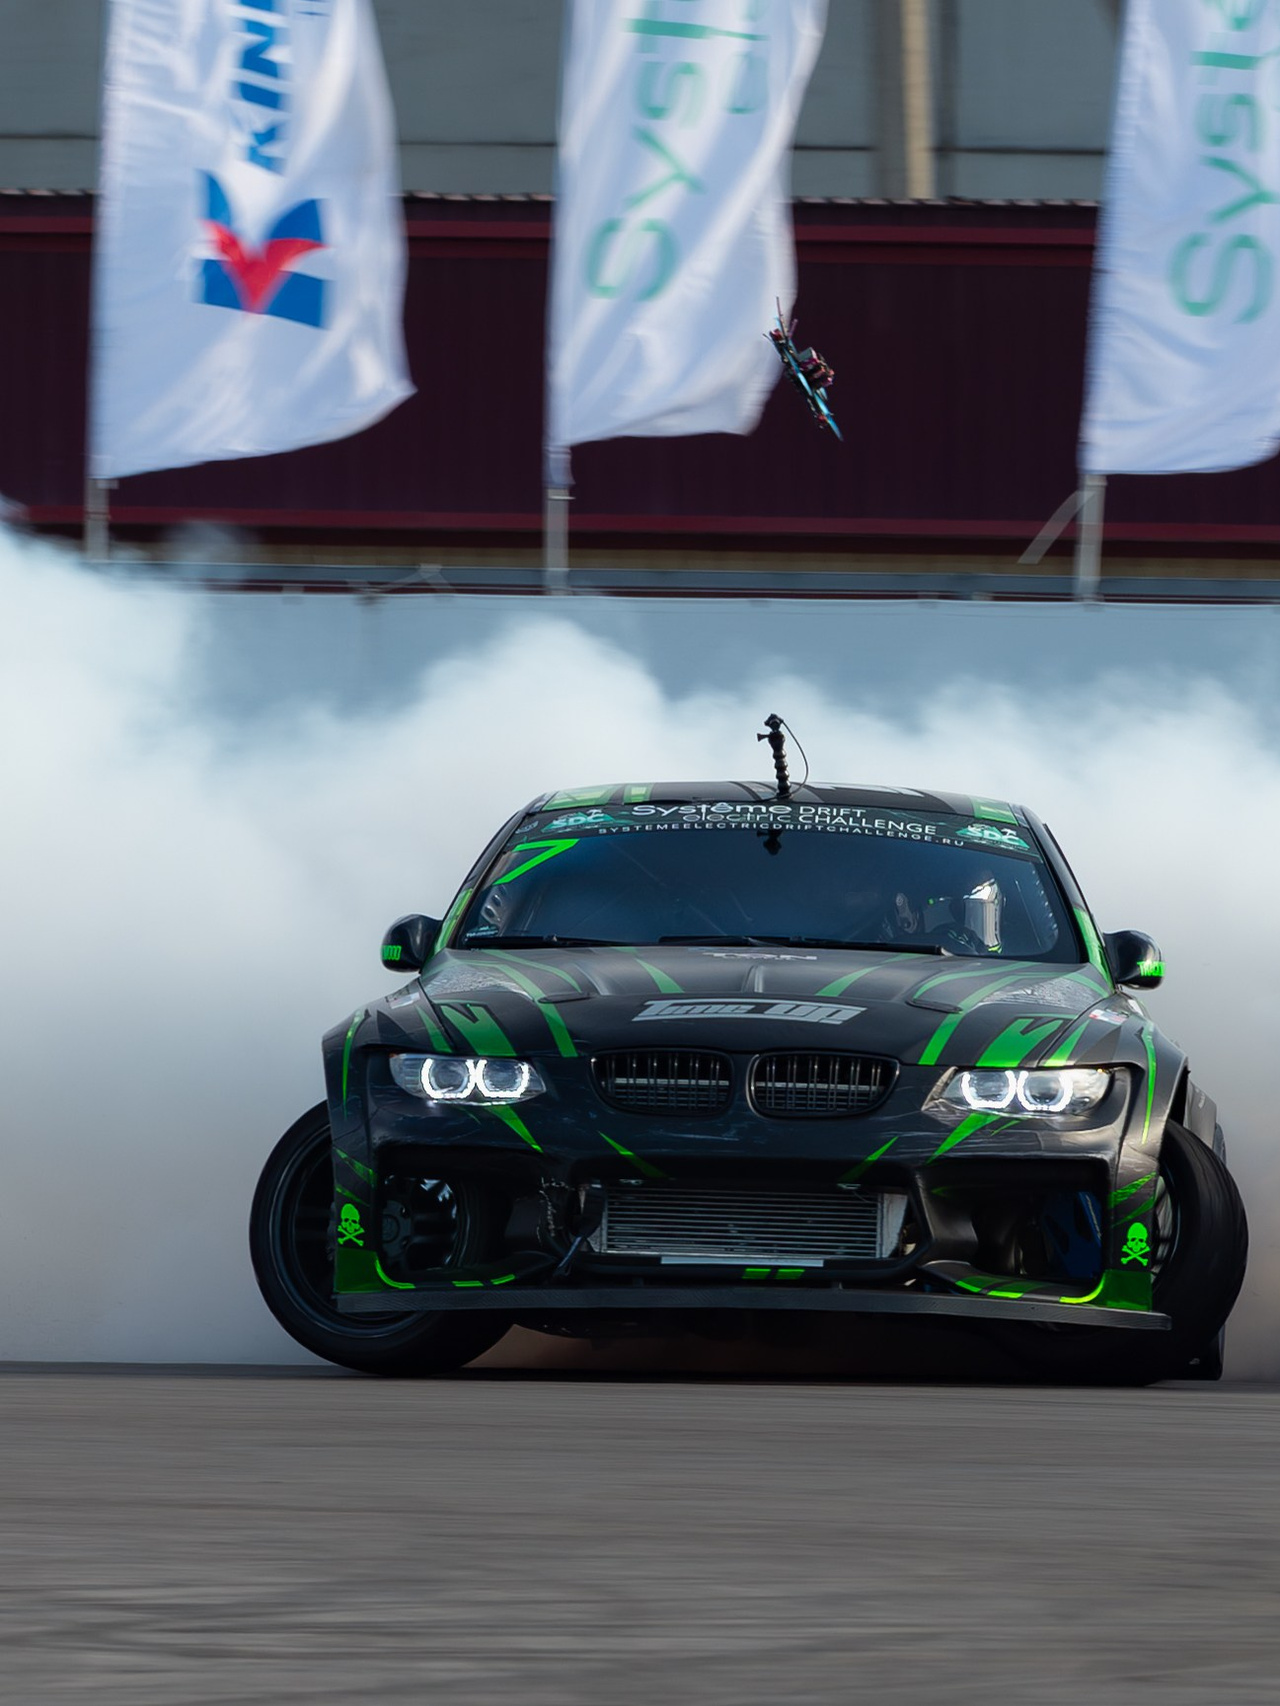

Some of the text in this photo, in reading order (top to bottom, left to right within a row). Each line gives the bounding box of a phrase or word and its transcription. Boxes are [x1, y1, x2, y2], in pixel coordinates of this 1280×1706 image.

[228, 0, 288, 178] KIN
[583, 0, 712, 301] Syst
[550, 814, 605, 829] SDC
[631, 802, 866, 818] Systême DRIFT
[598, 822, 965, 847] SYSTEMEELECTRICDRIFTCHALLENGE.RU
[682, 812, 937, 835] electric CHALLENGE
[966, 828, 1020, 846] SDC
[492, 838, 580, 886] 7
